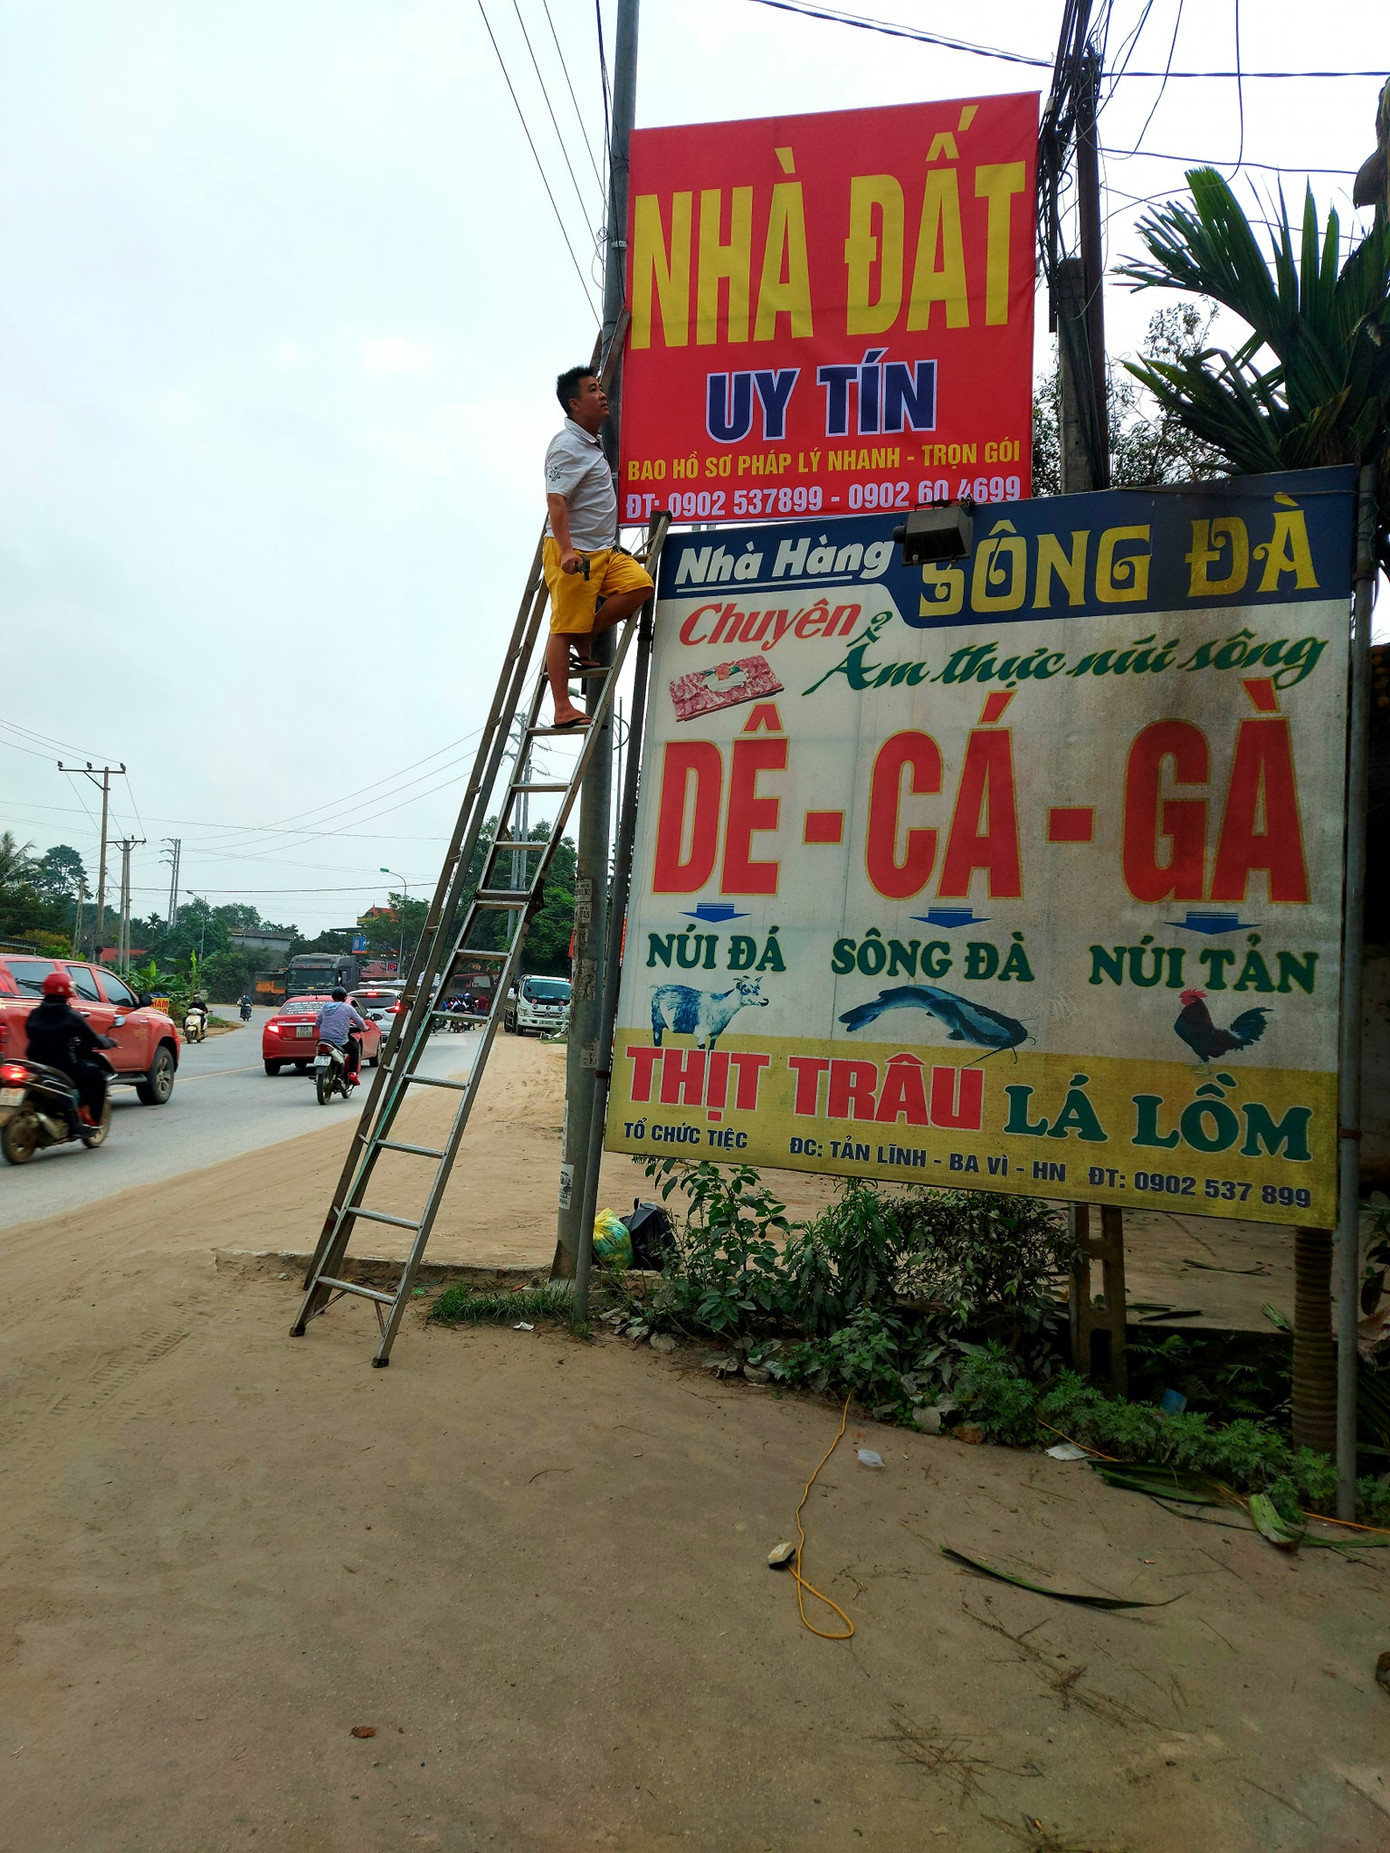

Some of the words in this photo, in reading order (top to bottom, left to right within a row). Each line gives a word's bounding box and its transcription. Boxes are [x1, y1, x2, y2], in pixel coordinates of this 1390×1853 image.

[630, 146, 814, 350] NHÀ
[844, 105, 1026, 336] ĐẤT
[706, 367, 801, 444] UY
[816, 347, 938, 437] TÍN
[628, 459, 666, 481] BAO
[673, 450, 699, 479] HỒ
[704, 453, 733, 478] SƠ
[738, 447, 791, 476] PHÁP
[799, 446, 822, 473] LÝ
[828, 447, 901, 472] NHANH
[922, 442, 977, 470] TRỌN
[985, 436, 1020, 463] GÓI
[667, 490, 725, 518] 0902
[733, 486, 823, 514] 537899
[848, 481, 910, 510] 0902
[917, 479, 949, 503] 60
[957, 475, 1021, 504] 4699
[674, 540, 763, 585] Nhà
[771, 534, 895, 579] Hàng
[918, 519, 1151, 617] SÔNG
[1185, 491, 1321, 597] ĐÀ
[679, 597, 862, 651] Chuyên
[802, 610, 931, 697] Ẩm
[931, 637, 1065, 689] thực
[1067, 633, 1180, 678] núi
[1177, 627, 1330, 691] sông
[651, 702, 790, 896] DÊ
[864, 690, 1024, 901] CÁ
[1121, 676, 1312, 905] GÀ
[646, 924, 719, 970] NÚI
[727, 926, 786, 972] ĐÁ
[831, 927, 953, 978] SÔNG
[964, 931, 1035, 982] ĐÀ
[1088, 935, 1186, 989] NÚI
[1199, 932, 1319, 994] TẢN
[626, 1045, 771, 1122] THỊT
[788, 1052, 984, 1132] TRÂU
[624, 1117, 647, 1140] TỔ
[651, 1122, 700, 1144] CHỨC
[707, 1126, 748, 1151] TIỆC
[1003, 1073, 1109, 1143] LÁ
[1130, 1072, 1313, 1163] LỒM
[790, 1137, 823, 1157] ĐC:
[830, 1134, 870, 1161] TẢN
[878, 1142, 926, 1168] LĨNH
[949, 1153, 979, 1174] BA
[987, 1152, 1008, 1177] VÌ
[1033, 1160, 1066, 1183] HN
[1089, 1167, 1126, 1189] ĐT:
[1134, 1171, 1196, 1196] 0902
[1204, 1178, 1253, 1202] 537
[1262, 1185, 1311, 1208] 899
